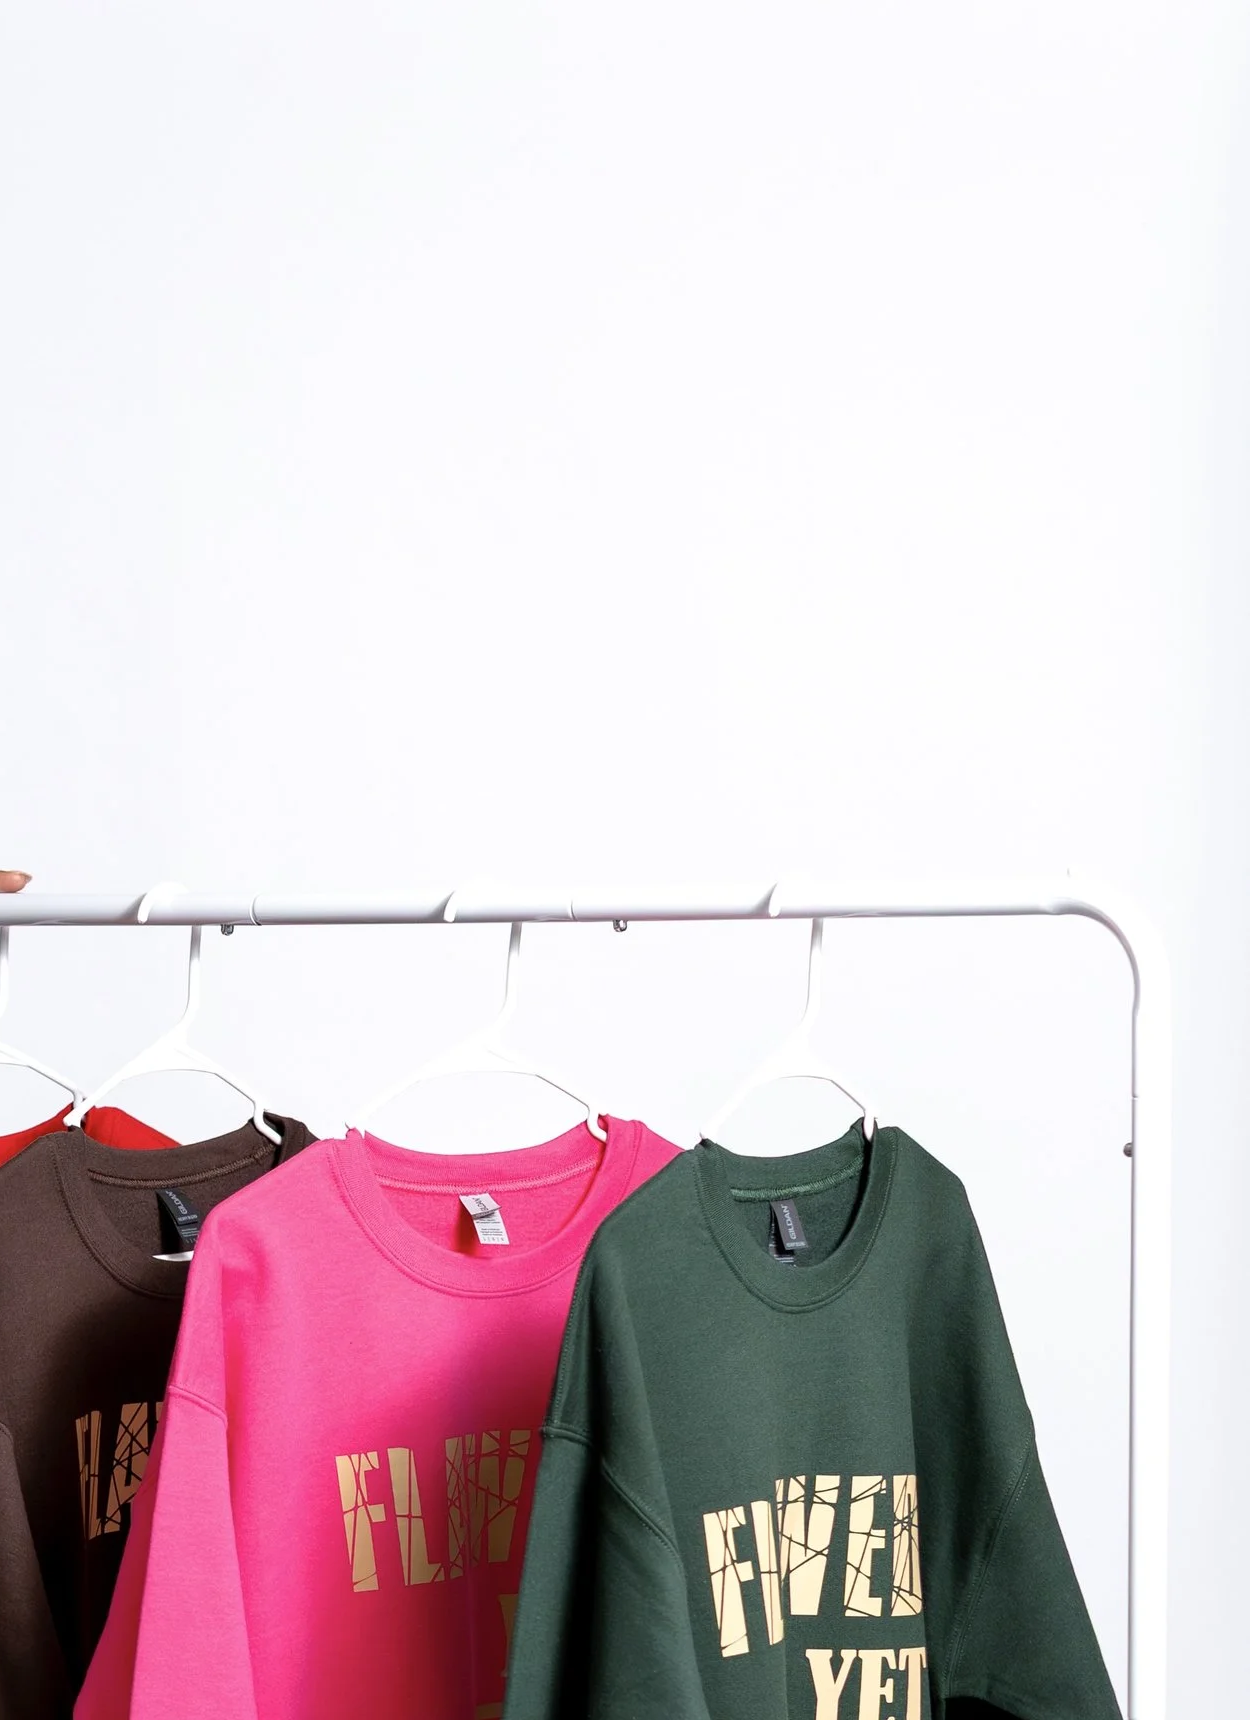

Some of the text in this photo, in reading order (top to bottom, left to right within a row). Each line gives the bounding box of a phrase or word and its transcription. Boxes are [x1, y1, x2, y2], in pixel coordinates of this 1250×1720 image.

[781, 1205, 797, 1240] GILDAN
[75, 1401, 163, 1540] FLA
[336, 1430, 531, 1592] FLAW
[703, 1475, 923, 1657] FLWED
